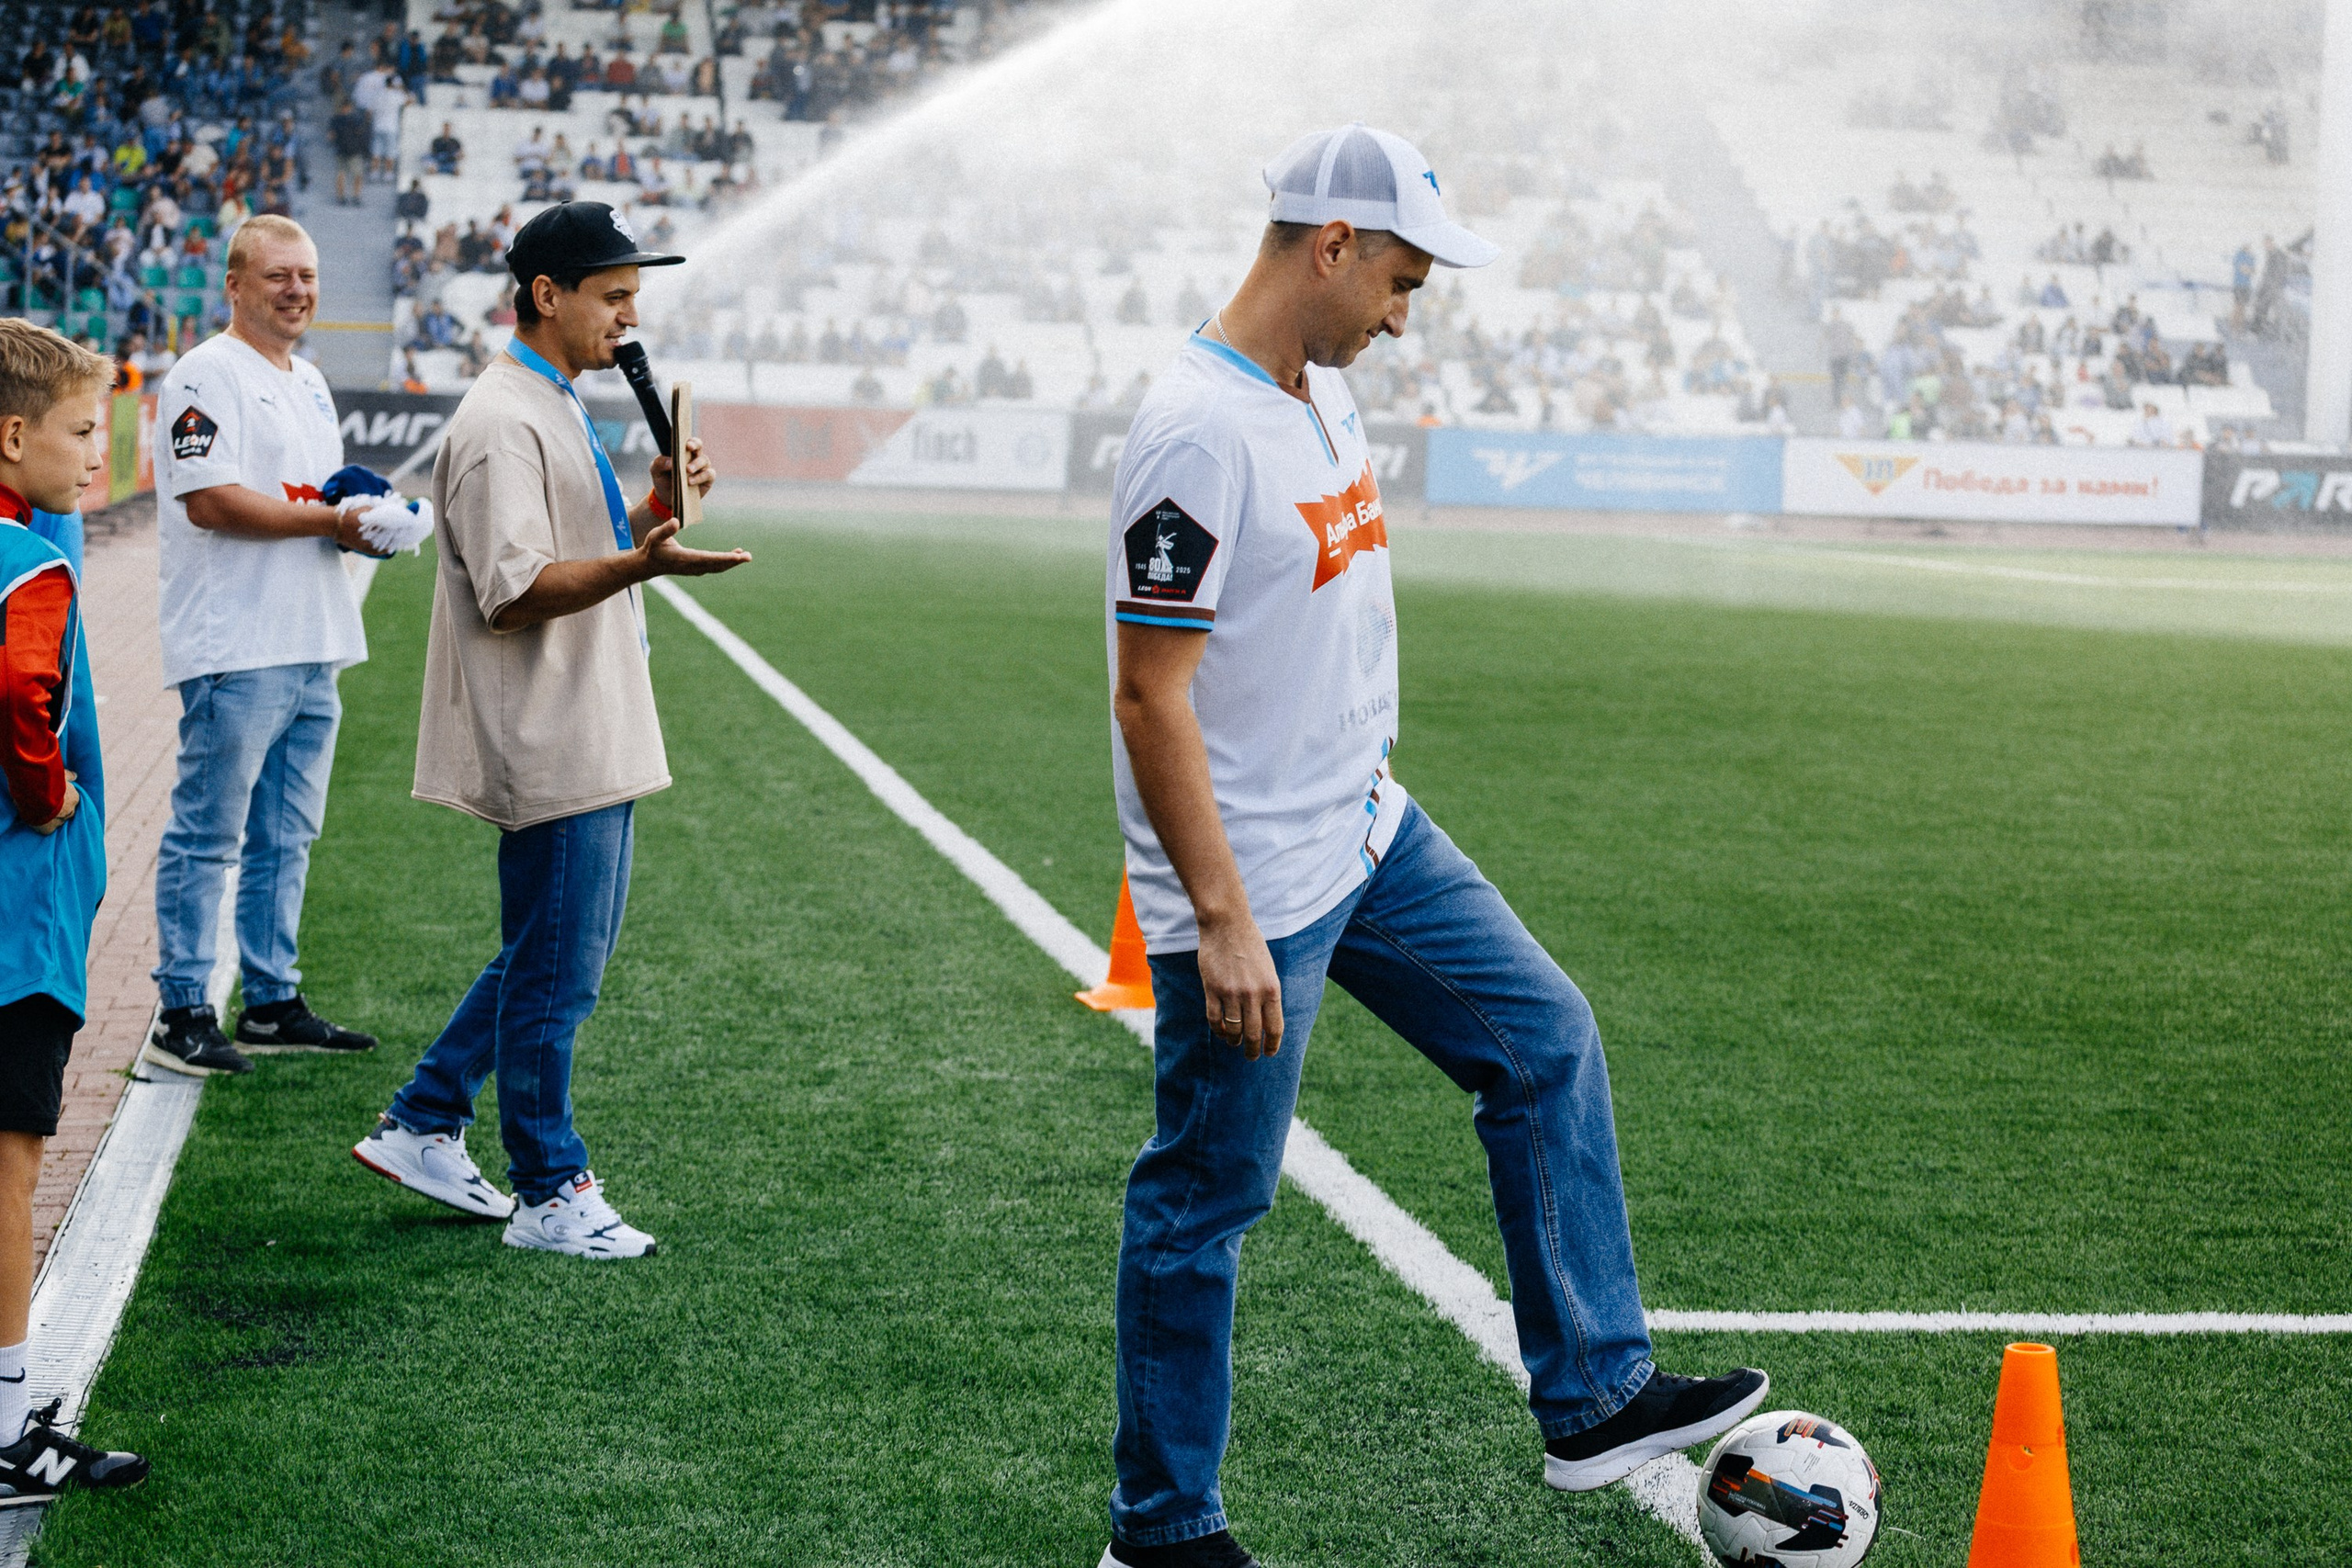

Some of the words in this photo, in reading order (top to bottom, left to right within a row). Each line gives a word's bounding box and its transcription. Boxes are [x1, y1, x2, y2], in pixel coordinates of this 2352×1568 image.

[175, 434, 212, 449] LEON
[1923, 468, 2029, 495] Победа
[1355, 497, 1383, 526] Бан
[1135, 562, 1147, 570] 1945
[1175, 566, 1192, 574] 2025
[26, 1446, 77, 1486] N
